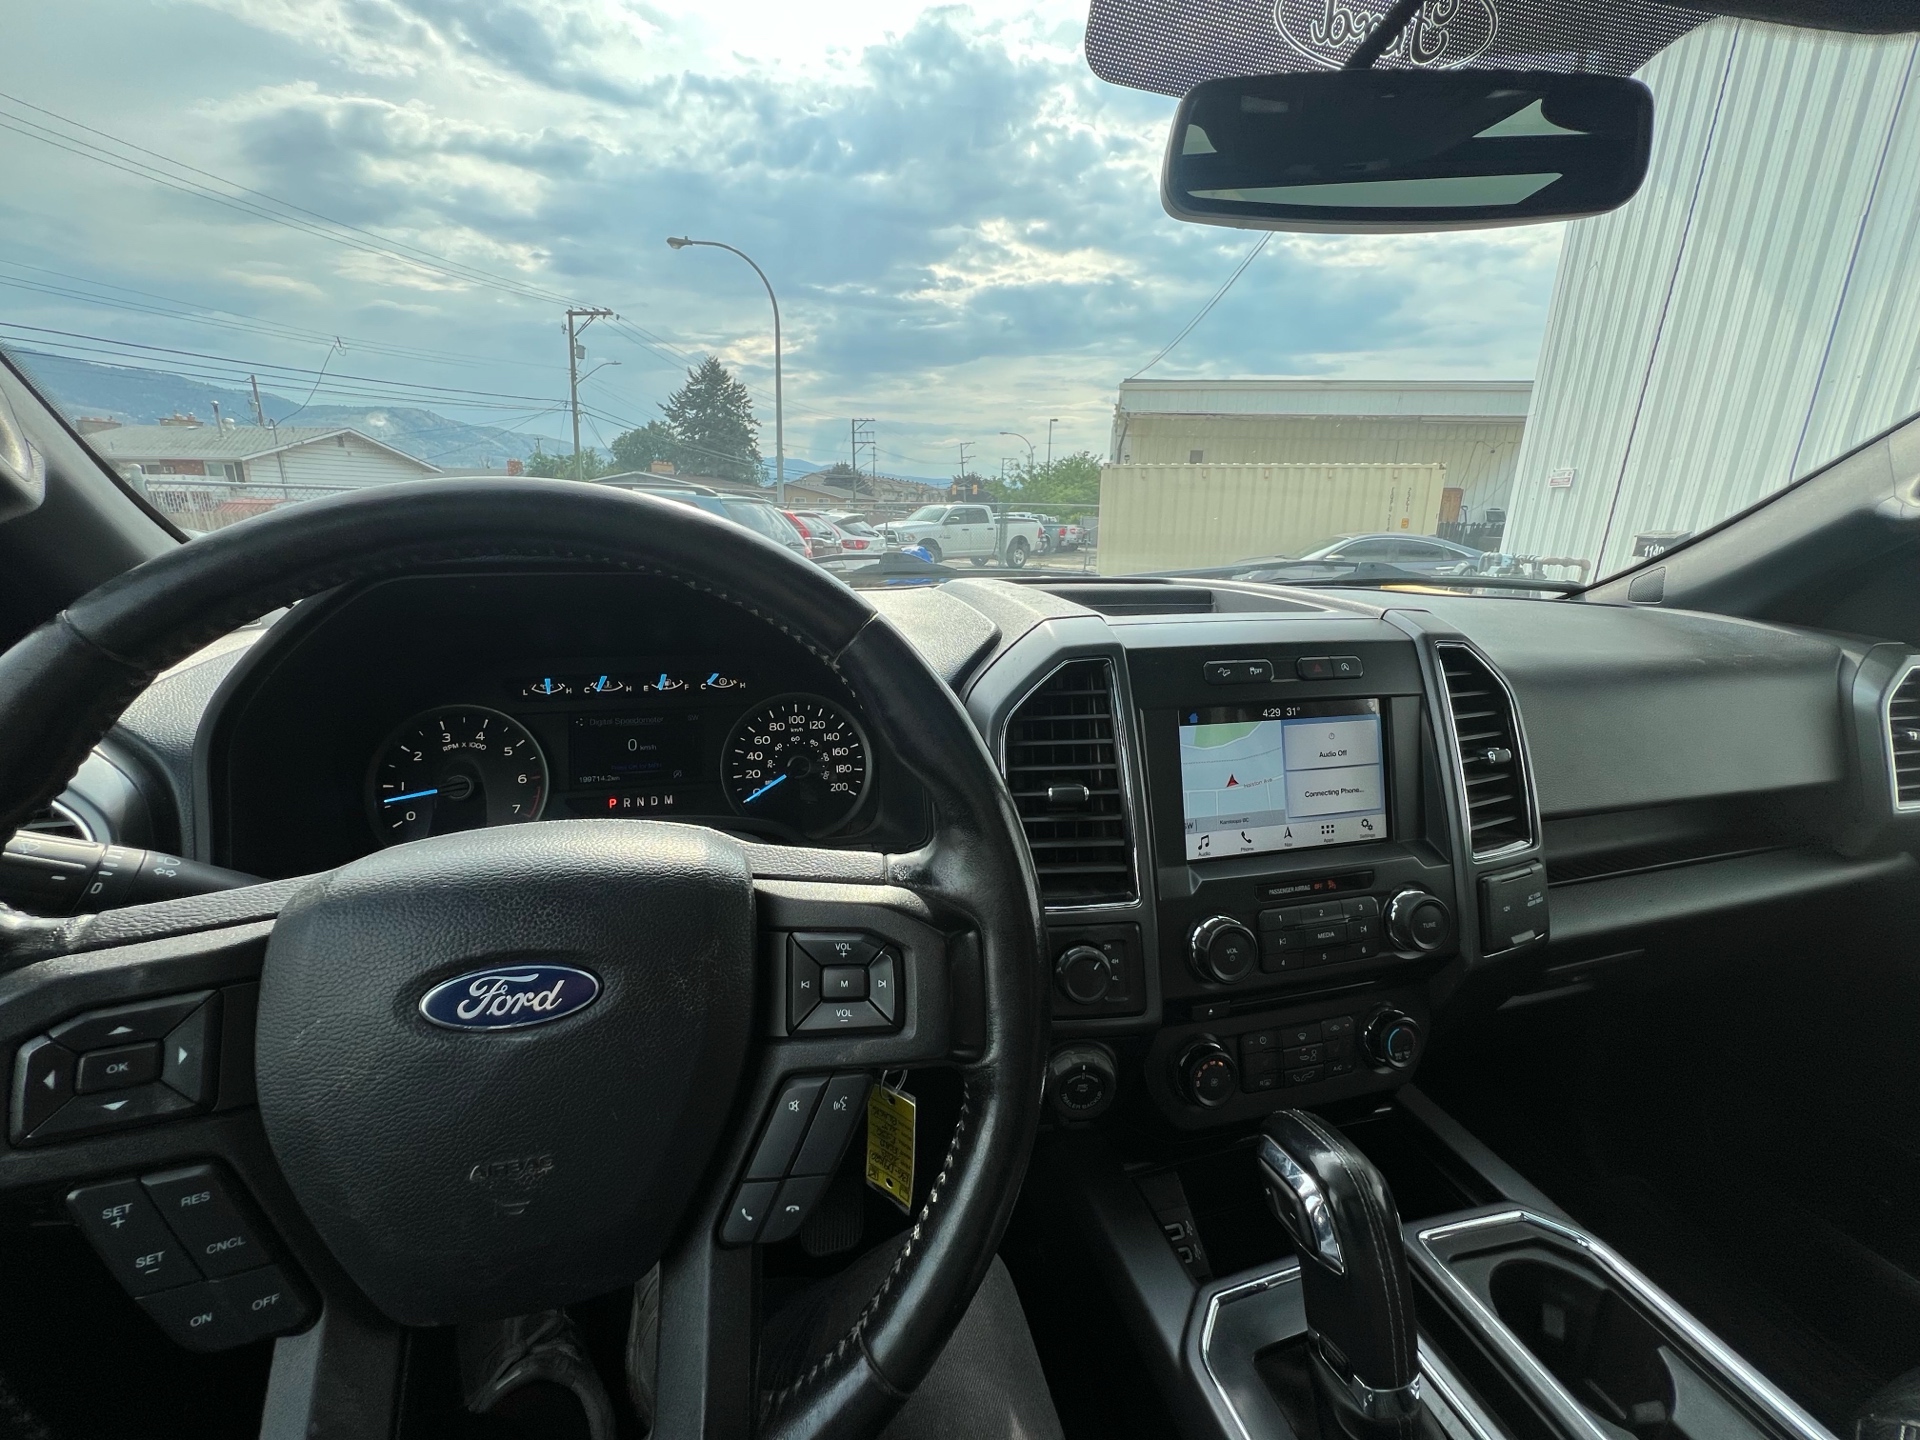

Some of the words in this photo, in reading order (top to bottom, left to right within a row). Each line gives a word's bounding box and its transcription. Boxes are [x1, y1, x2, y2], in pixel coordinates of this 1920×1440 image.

[1262, 707, 1281, 718] 4:29
[788, 715, 805, 724] 100
[769, 722, 785, 731] 80
[809, 721, 826, 730] 120
[442, 733, 451, 742] 3
[475, 731, 485, 740] 4
[823, 732, 840, 741] 140
[627, 738, 638, 752] 0
[754, 736, 771, 745] 60
[442, 743, 459, 752] RPM
[504, 747, 513, 756] 5
[832, 747, 849, 756] 160
[413, 752, 422, 761] 2
[746, 751, 763, 761] 40
[1319, 750, 1335, 758] Audio
[1335, 749, 1347, 757] Off
[836, 765, 852, 773] 180
[517, 774, 527, 784] 6
[745, 770, 761, 779] 20
[830, 783, 849, 792] 200
[1304, 788, 1339, 798] Connecting
[609, 798, 617, 809] P
[624, 798, 630, 807] R
[637, 797, 645, 807] N
[651, 796, 658, 806] D
[664, 795, 673, 805] M
[512, 804, 521, 813] 7
[406, 811, 416, 821] 0
[1268, 887, 1294, 895] PASSENGER
[1319, 909, 1324, 917] 2
[1279, 914, 1282, 922] 1
[1422, 921, 1436, 929] TUNE
[1317, 931, 1335, 939] MEDIA
[1226, 947, 1238, 955] VOL
[1322, 952, 1327, 960] 5
[456, 973, 565, 1020] Ford
[836, 1009, 853, 1017] VOL
[106, 1062, 129, 1074] OK
[181, 1191, 210, 1207] RES
[102, 1202, 133, 1220] SET
[206, 1237, 246, 1254] CNCL
[135, 1251, 166, 1268] SET
[252, 1293, 280, 1311] OFF
[190, 1313, 212, 1327] ON
